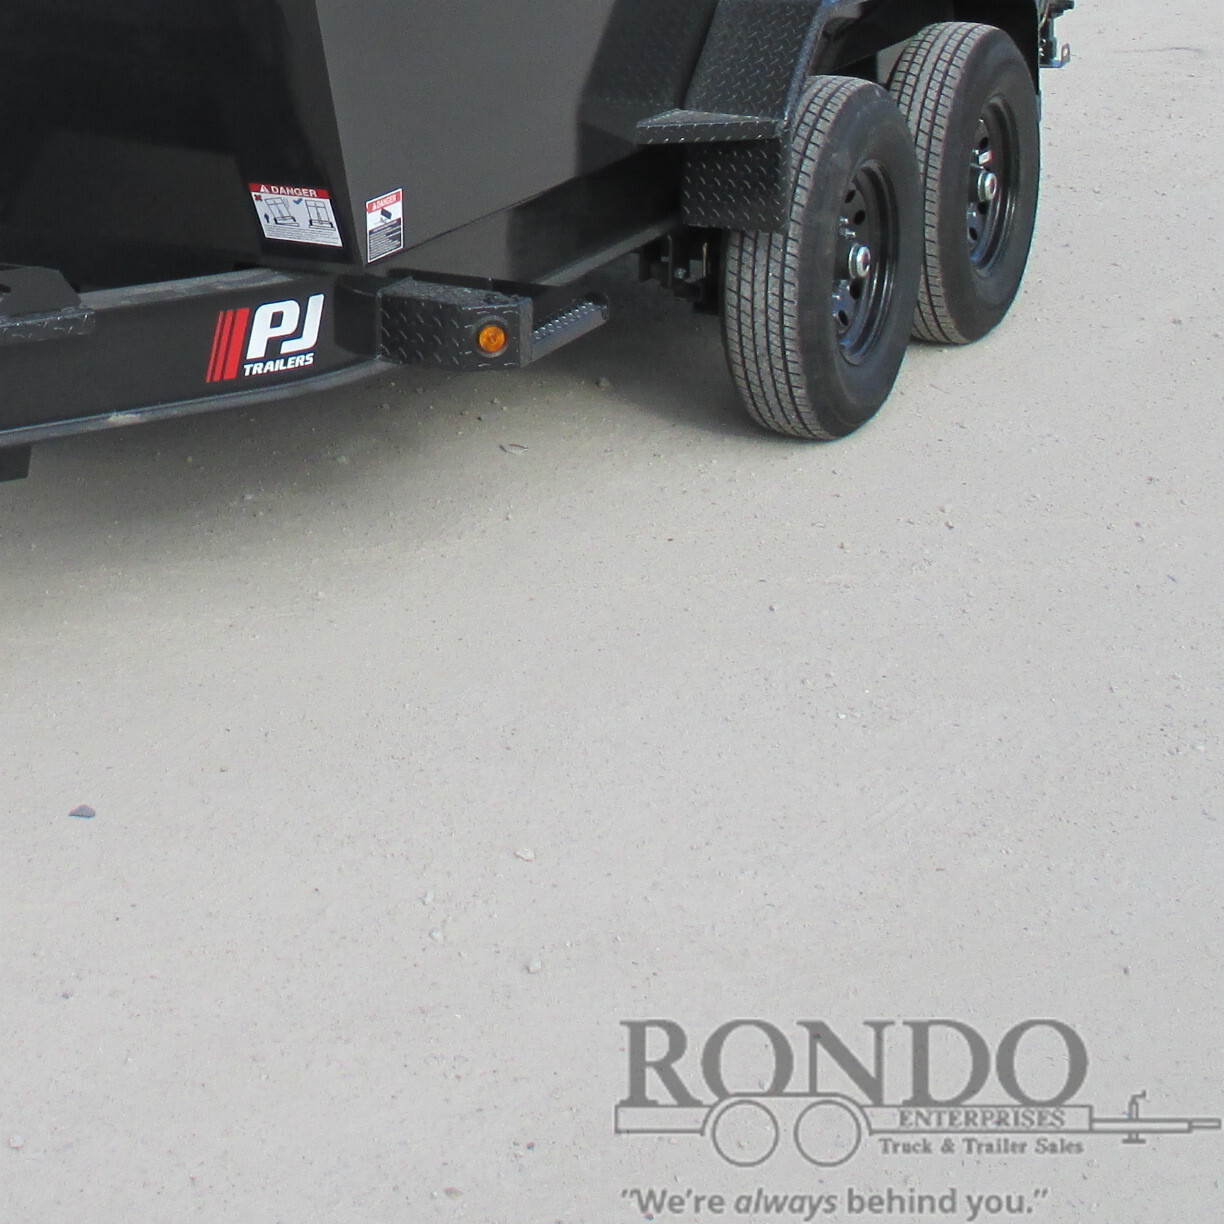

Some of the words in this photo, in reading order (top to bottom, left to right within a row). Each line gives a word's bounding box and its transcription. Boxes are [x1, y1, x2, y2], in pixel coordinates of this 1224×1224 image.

[271, 185, 318, 198] DANGER
[376, 193, 397, 209] DANGER
[246, 294, 325, 360] PJ
[244, 353, 315, 376] TRAILERS
